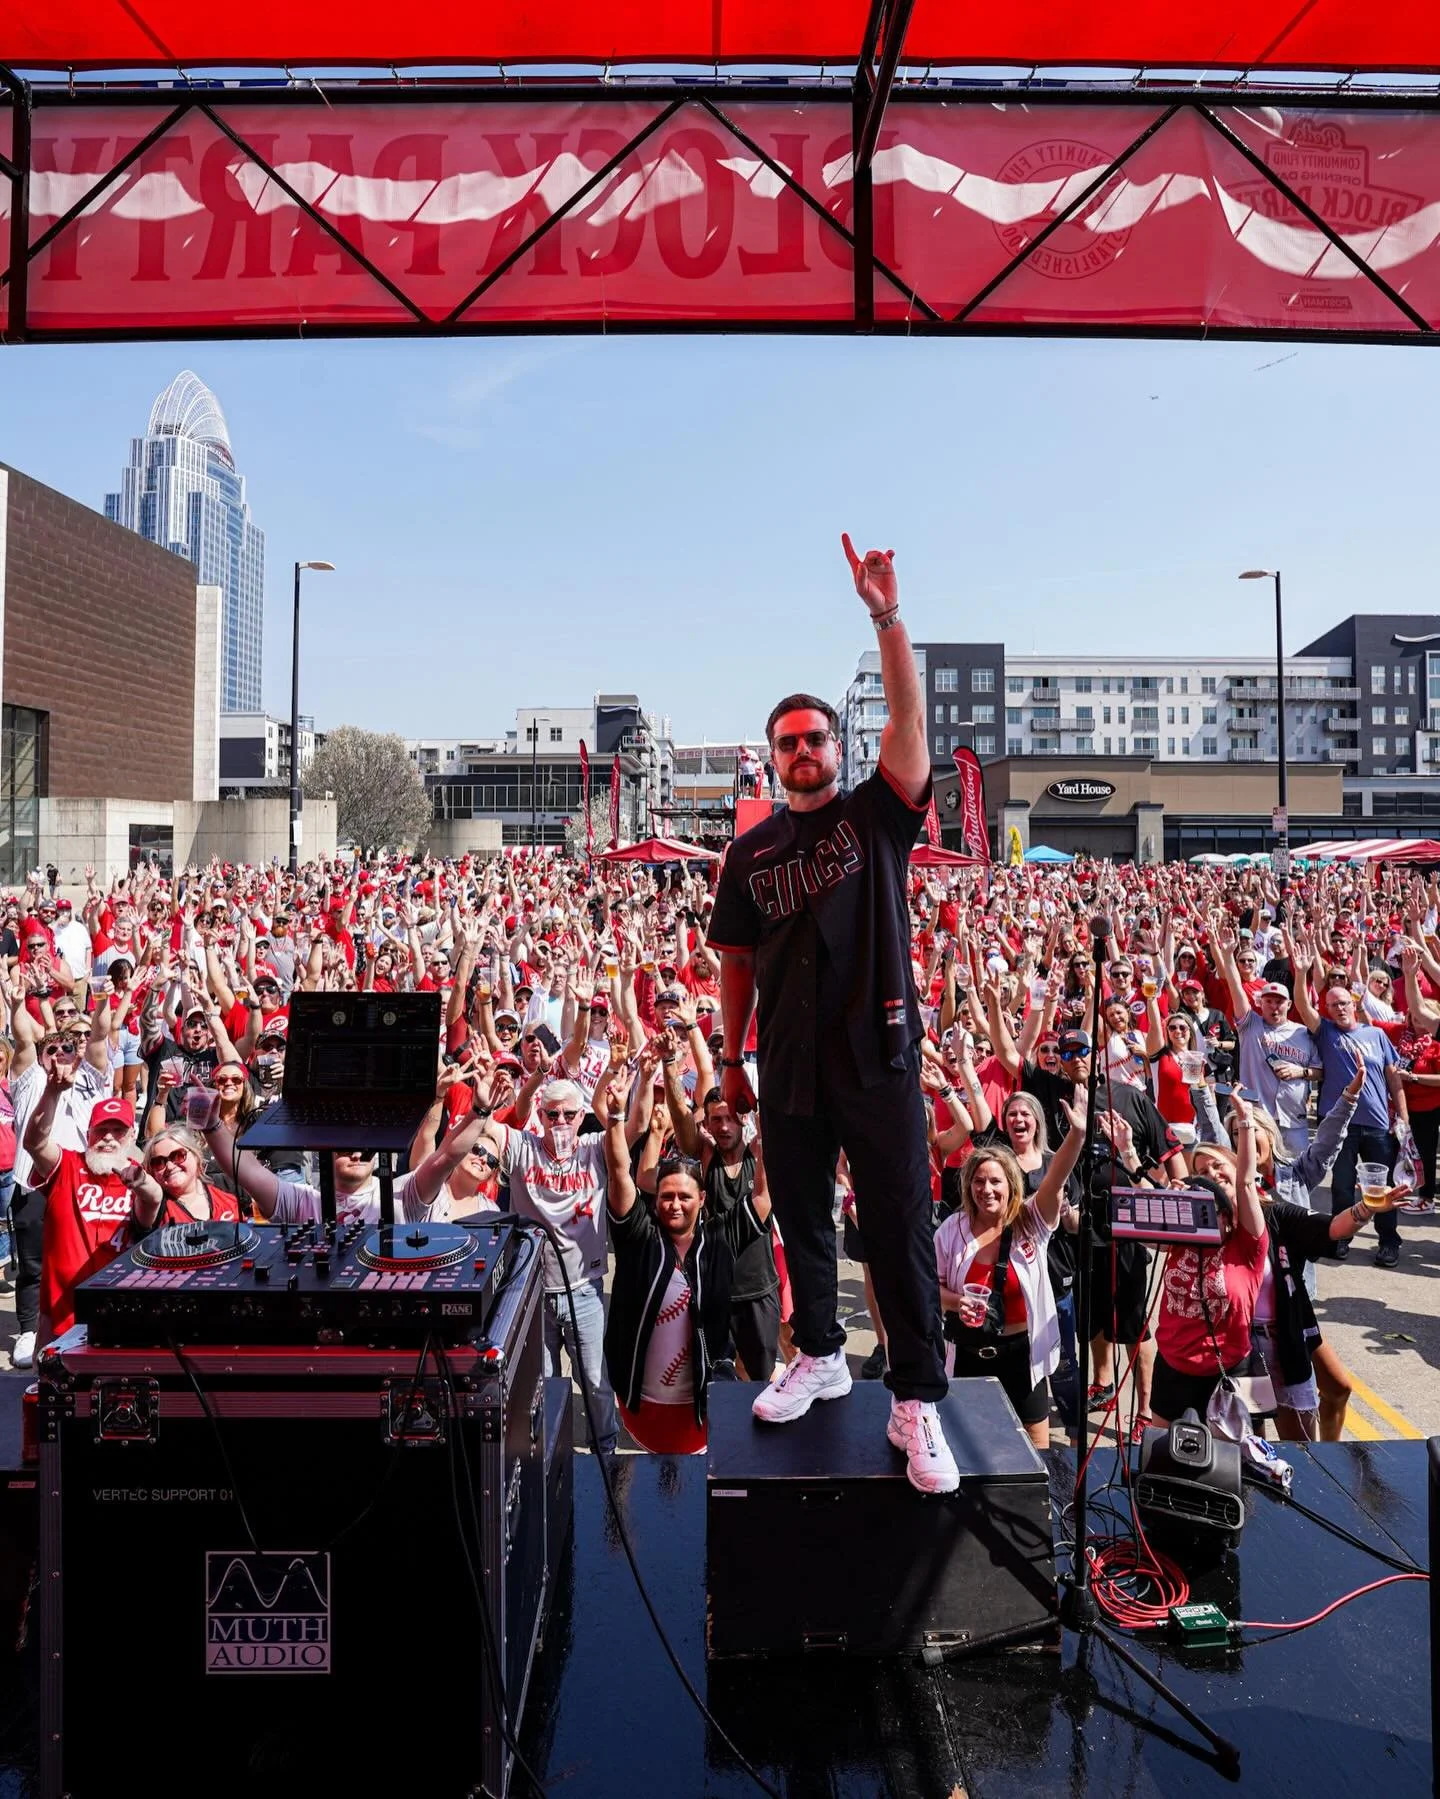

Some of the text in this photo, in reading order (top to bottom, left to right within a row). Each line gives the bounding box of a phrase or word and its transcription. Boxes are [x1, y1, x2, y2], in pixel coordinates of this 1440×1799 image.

[1056, 783, 1112, 795] Yard House
[966, 764, 983, 857] Budweiser
[749, 820, 865, 920] CINCY
[103, 1101, 121, 1113] C
[77, 1183, 131, 1213] Red
[442, 1303, 473, 1316] RANE
[151, 1488, 216, 1501] SUPPORT
[219, 1488, 233, 1501] 01
[209, 1618, 326, 1641] MUTH
[210, 1645, 326, 1665] AUDIO
